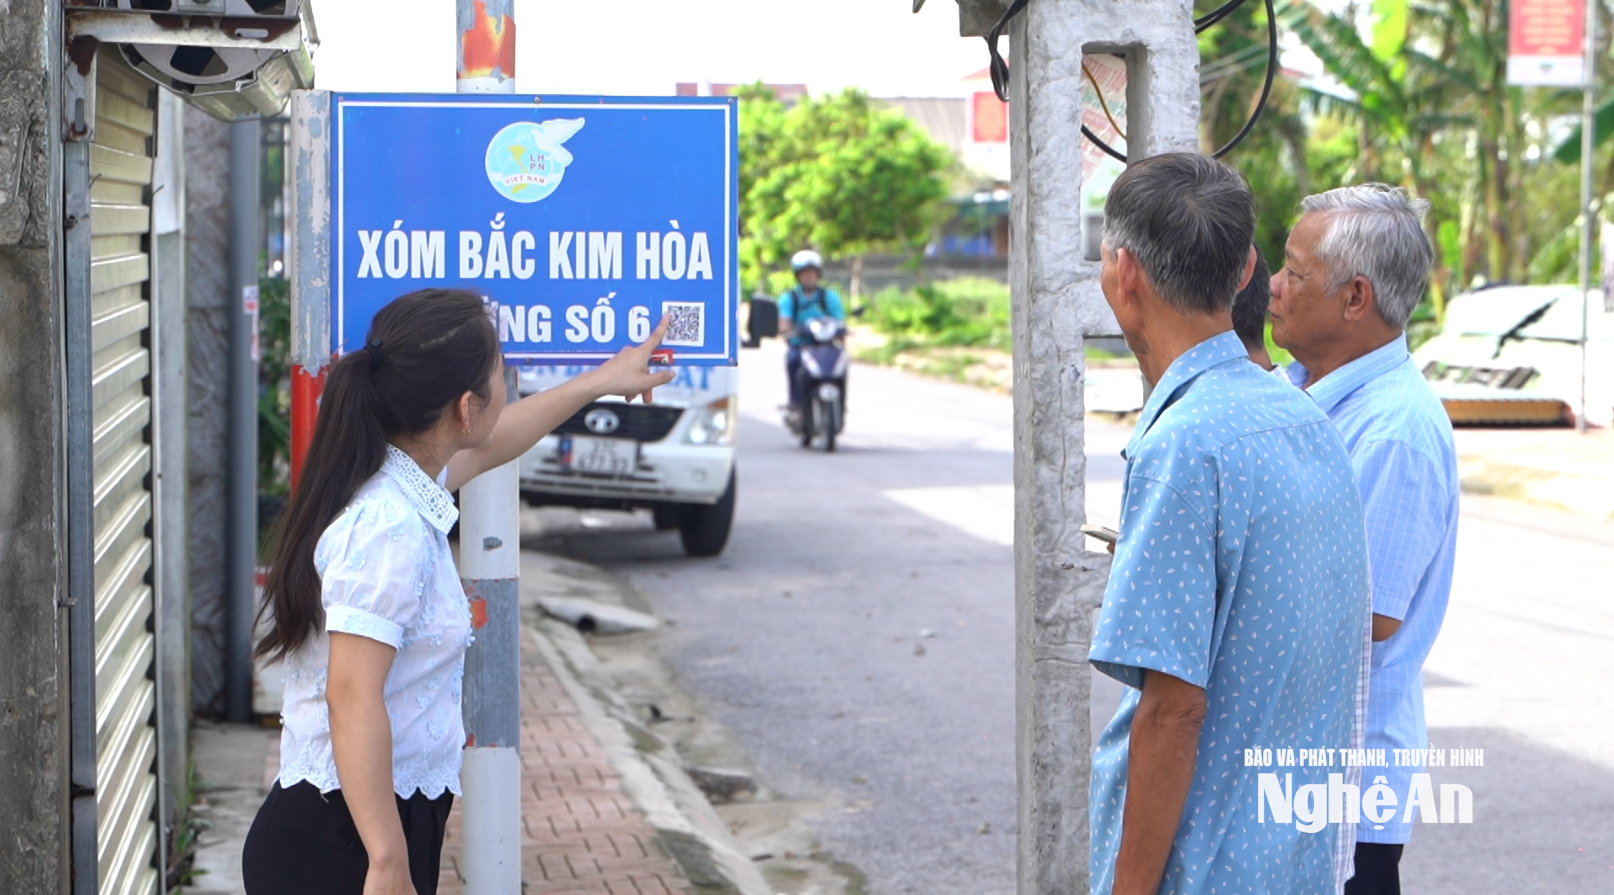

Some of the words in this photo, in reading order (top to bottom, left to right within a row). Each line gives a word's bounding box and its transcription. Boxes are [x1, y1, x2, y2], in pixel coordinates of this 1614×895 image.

[530, 154, 544, 162] LH
[526, 175, 546, 184] NAM
[357, 220, 445, 278] XÓM
[459, 212, 536, 279] BẮC
[549, 231, 622, 279] KIM
[636, 220, 713, 280] HÒA
[564, 292, 616, 343] SỐ
[628, 306, 650, 343] 6
